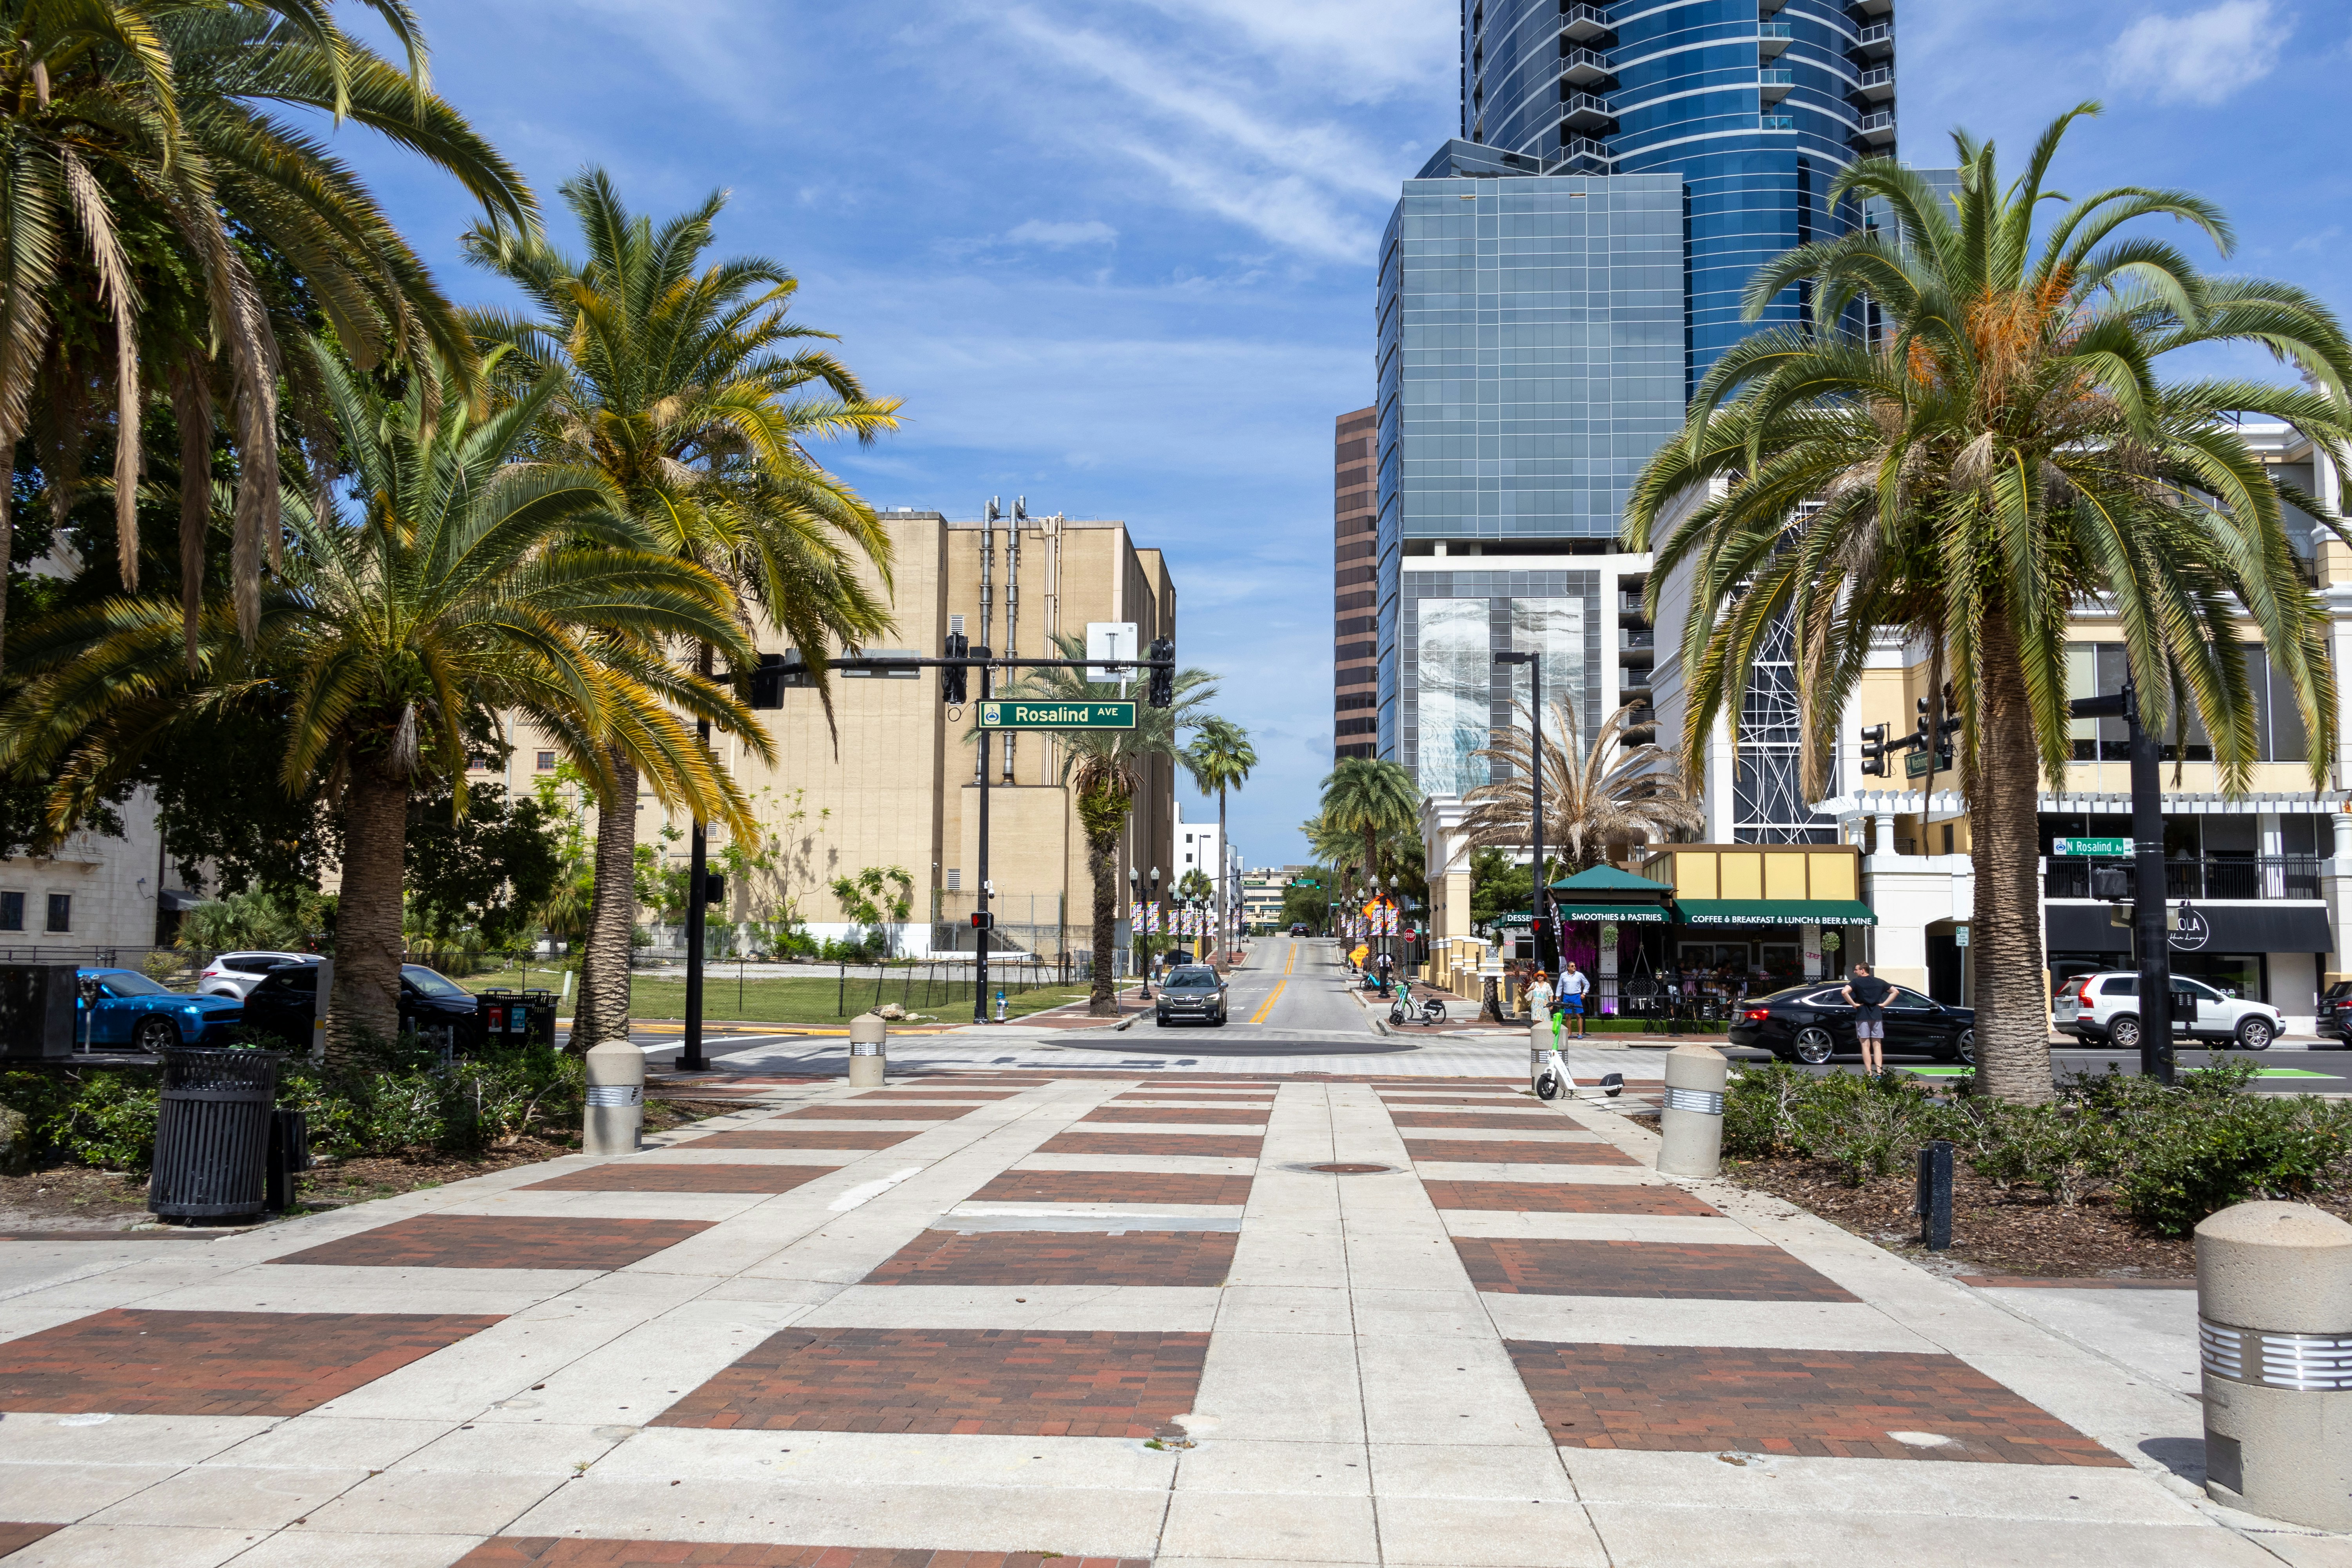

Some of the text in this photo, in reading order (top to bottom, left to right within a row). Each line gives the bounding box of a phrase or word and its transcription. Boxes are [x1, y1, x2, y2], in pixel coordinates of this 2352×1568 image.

[1016, 706, 1118, 722] Rosalind AVE
[2067, 841, 2073, 852] N
[2076, 841, 2111, 852] Rosalind
[2176, 918, 2200, 931] OLA
[2185, 933, 2205, 942] Lounge
